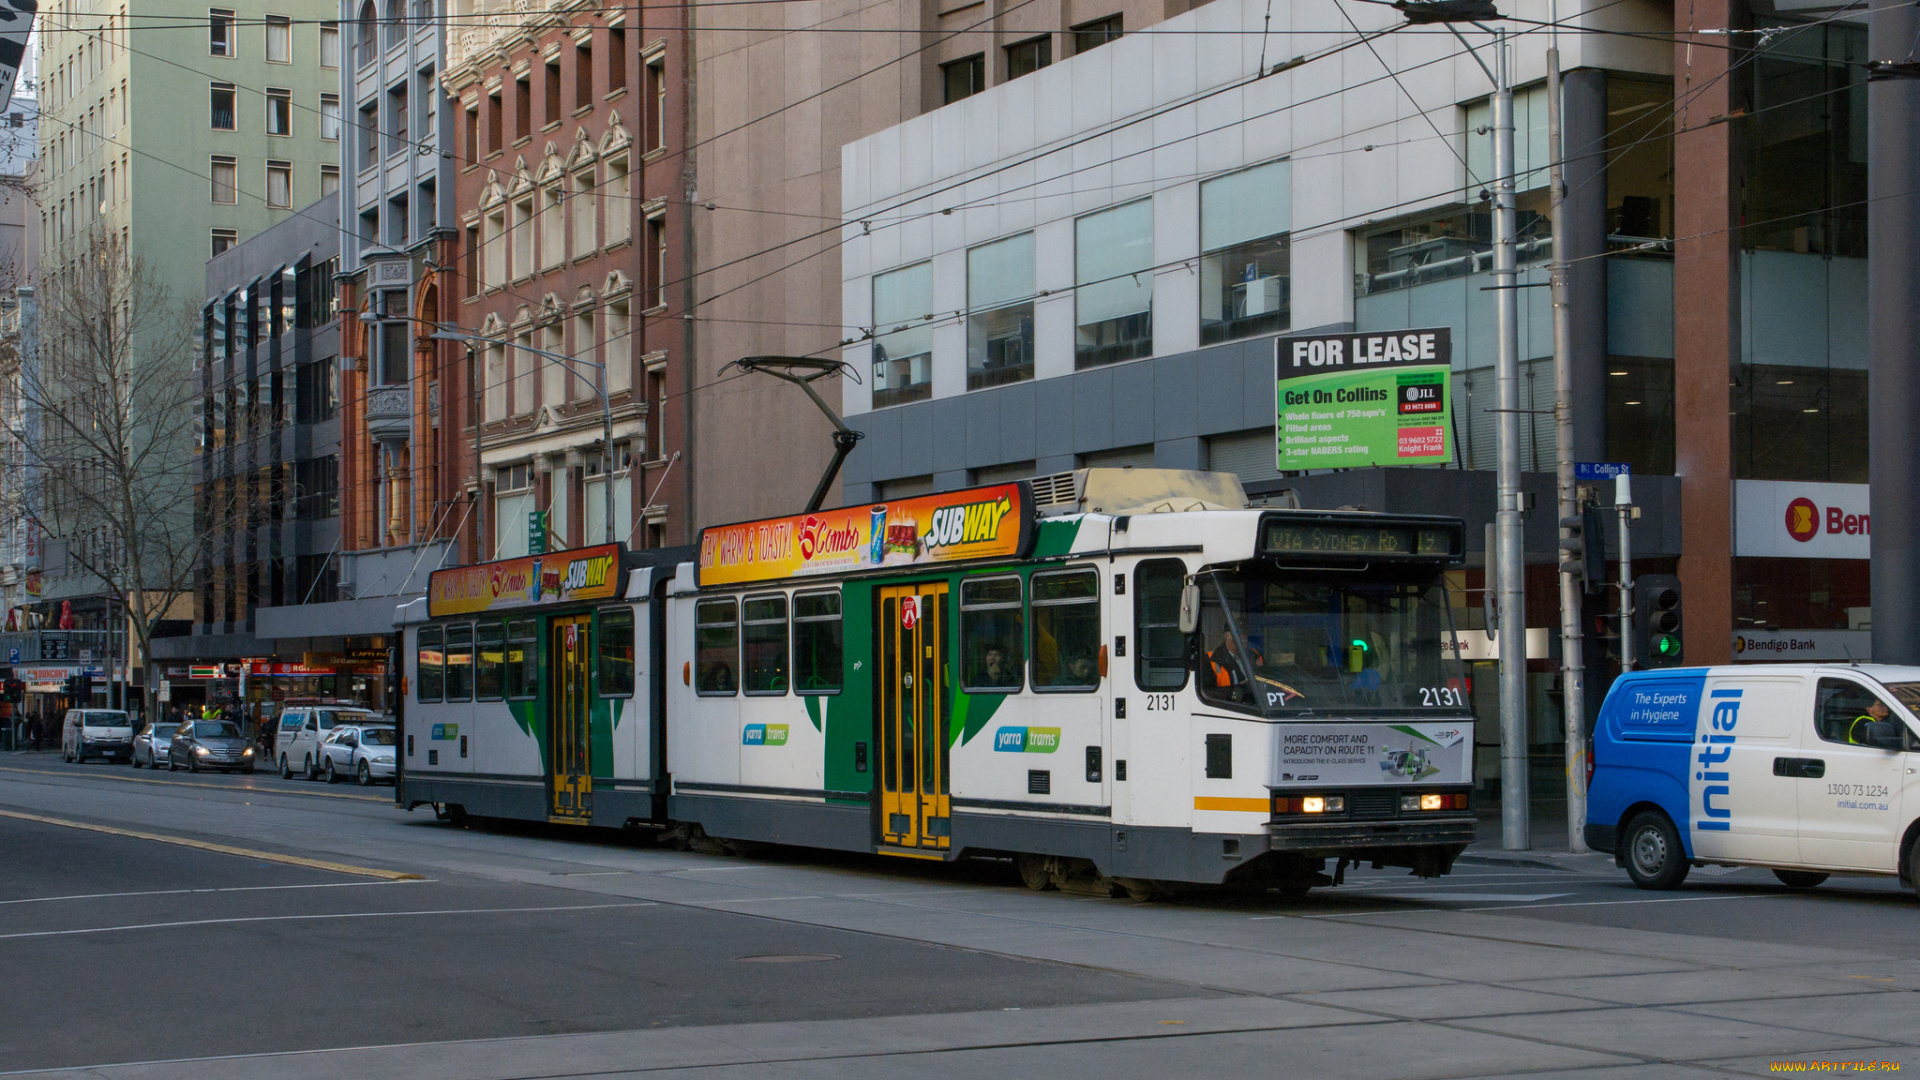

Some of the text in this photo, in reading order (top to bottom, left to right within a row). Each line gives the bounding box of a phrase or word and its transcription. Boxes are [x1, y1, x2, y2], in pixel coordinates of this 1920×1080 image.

[1293, 334, 1436, 367] FOR LEASE
[1285, 387, 1388, 405] Get On Collins
[1419, 388, 1435, 399] JLL
[1285, 412, 1310, 421] Whole
[1311, 411, 1334, 420] floors
[1336, 410, 1344, 418] of
[1285, 424, 1308, 432] Fitted
[1286, 434, 1349, 444] Brilliant aspects
[1286, 448, 1309, 456] 3-star
[1344, 445, 1369, 455] rating
[1398, 444, 1443, 454] Knight Frank
[1594, 463, 1629, 475] Collins St
[924, 490, 1012, 554] SUBWAY
[720, 528, 745, 566] WARM
[747, 529, 754, 563] &
[758, 521, 793, 562] TOASTY!
[815, 517, 859, 555] Combo
[562, 550, 614, 591] SUBWAY
[500, 567, 527, 594] Combo
[1748, 639, 1815, 653] Bendigo Bank
[10, 649, 18, 658] P
[1147, 695, 1175, 711] 2131
[1419, 687, 1463, 707] 2131
[1635, 692, 1687, 707] The Experts
[1631, 710, 1680, 723] in Hygiene
[745, 728, 786, 742] yarra trams
[998, 731, 1056, 748] yarra trams
[1284, 735, 1308, 744] MORE
[1310, 735, 1348, 744] COMFORT
[1350, 735, 1368, 744] AND
[1283, 745, 1374, 756] CAPACITY ON ROUTE 11
[1696, 689, 1743, 831] Initial
[1827, 783, 1888, 798] 1300 73 1234
[1837, 799, 1889, 811] initial.com.au
